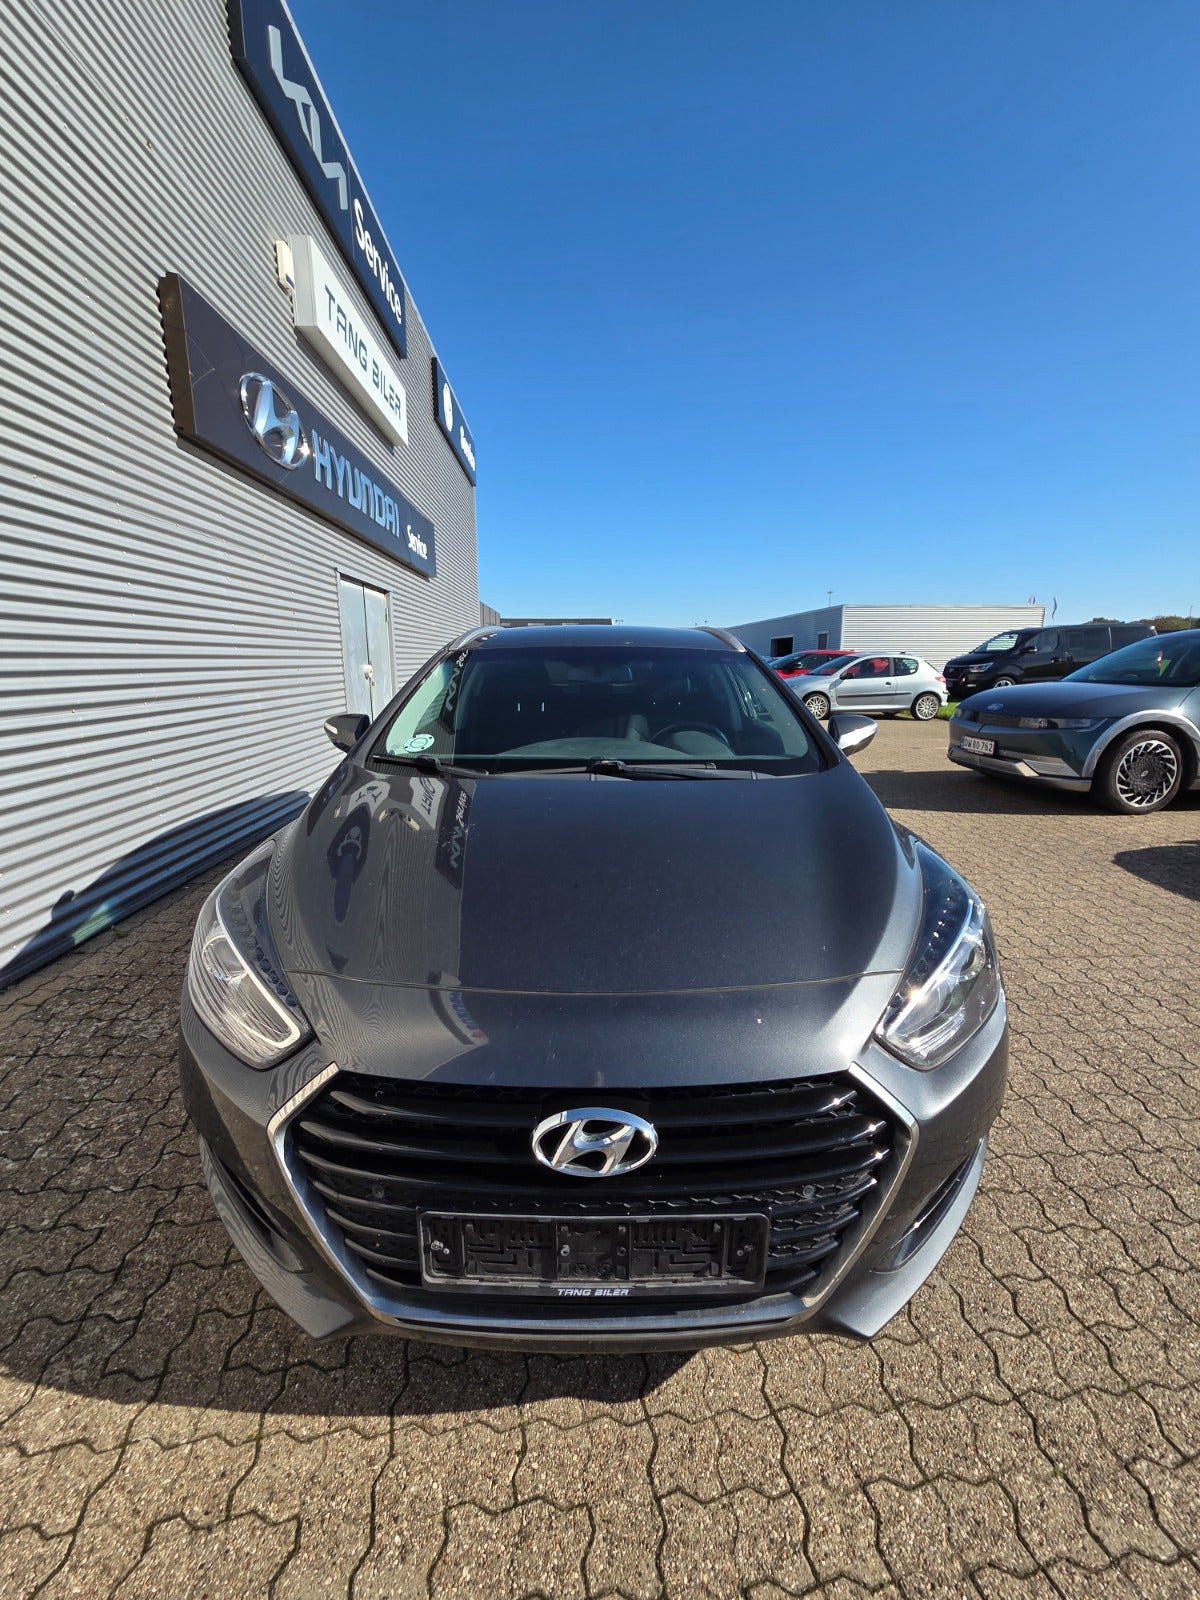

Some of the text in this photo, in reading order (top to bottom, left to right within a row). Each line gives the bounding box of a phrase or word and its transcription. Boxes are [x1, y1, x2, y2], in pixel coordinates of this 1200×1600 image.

[354, 198, 402, 325] Service
[325, 284, 402, 420] TANG BILER
[312, 429, 400, 538] HYUNDAI
[406, 524, 428, 560] Service
[981, 741, 993, 752] 762
[557, 1288, 630, 1296] TANG BILER
